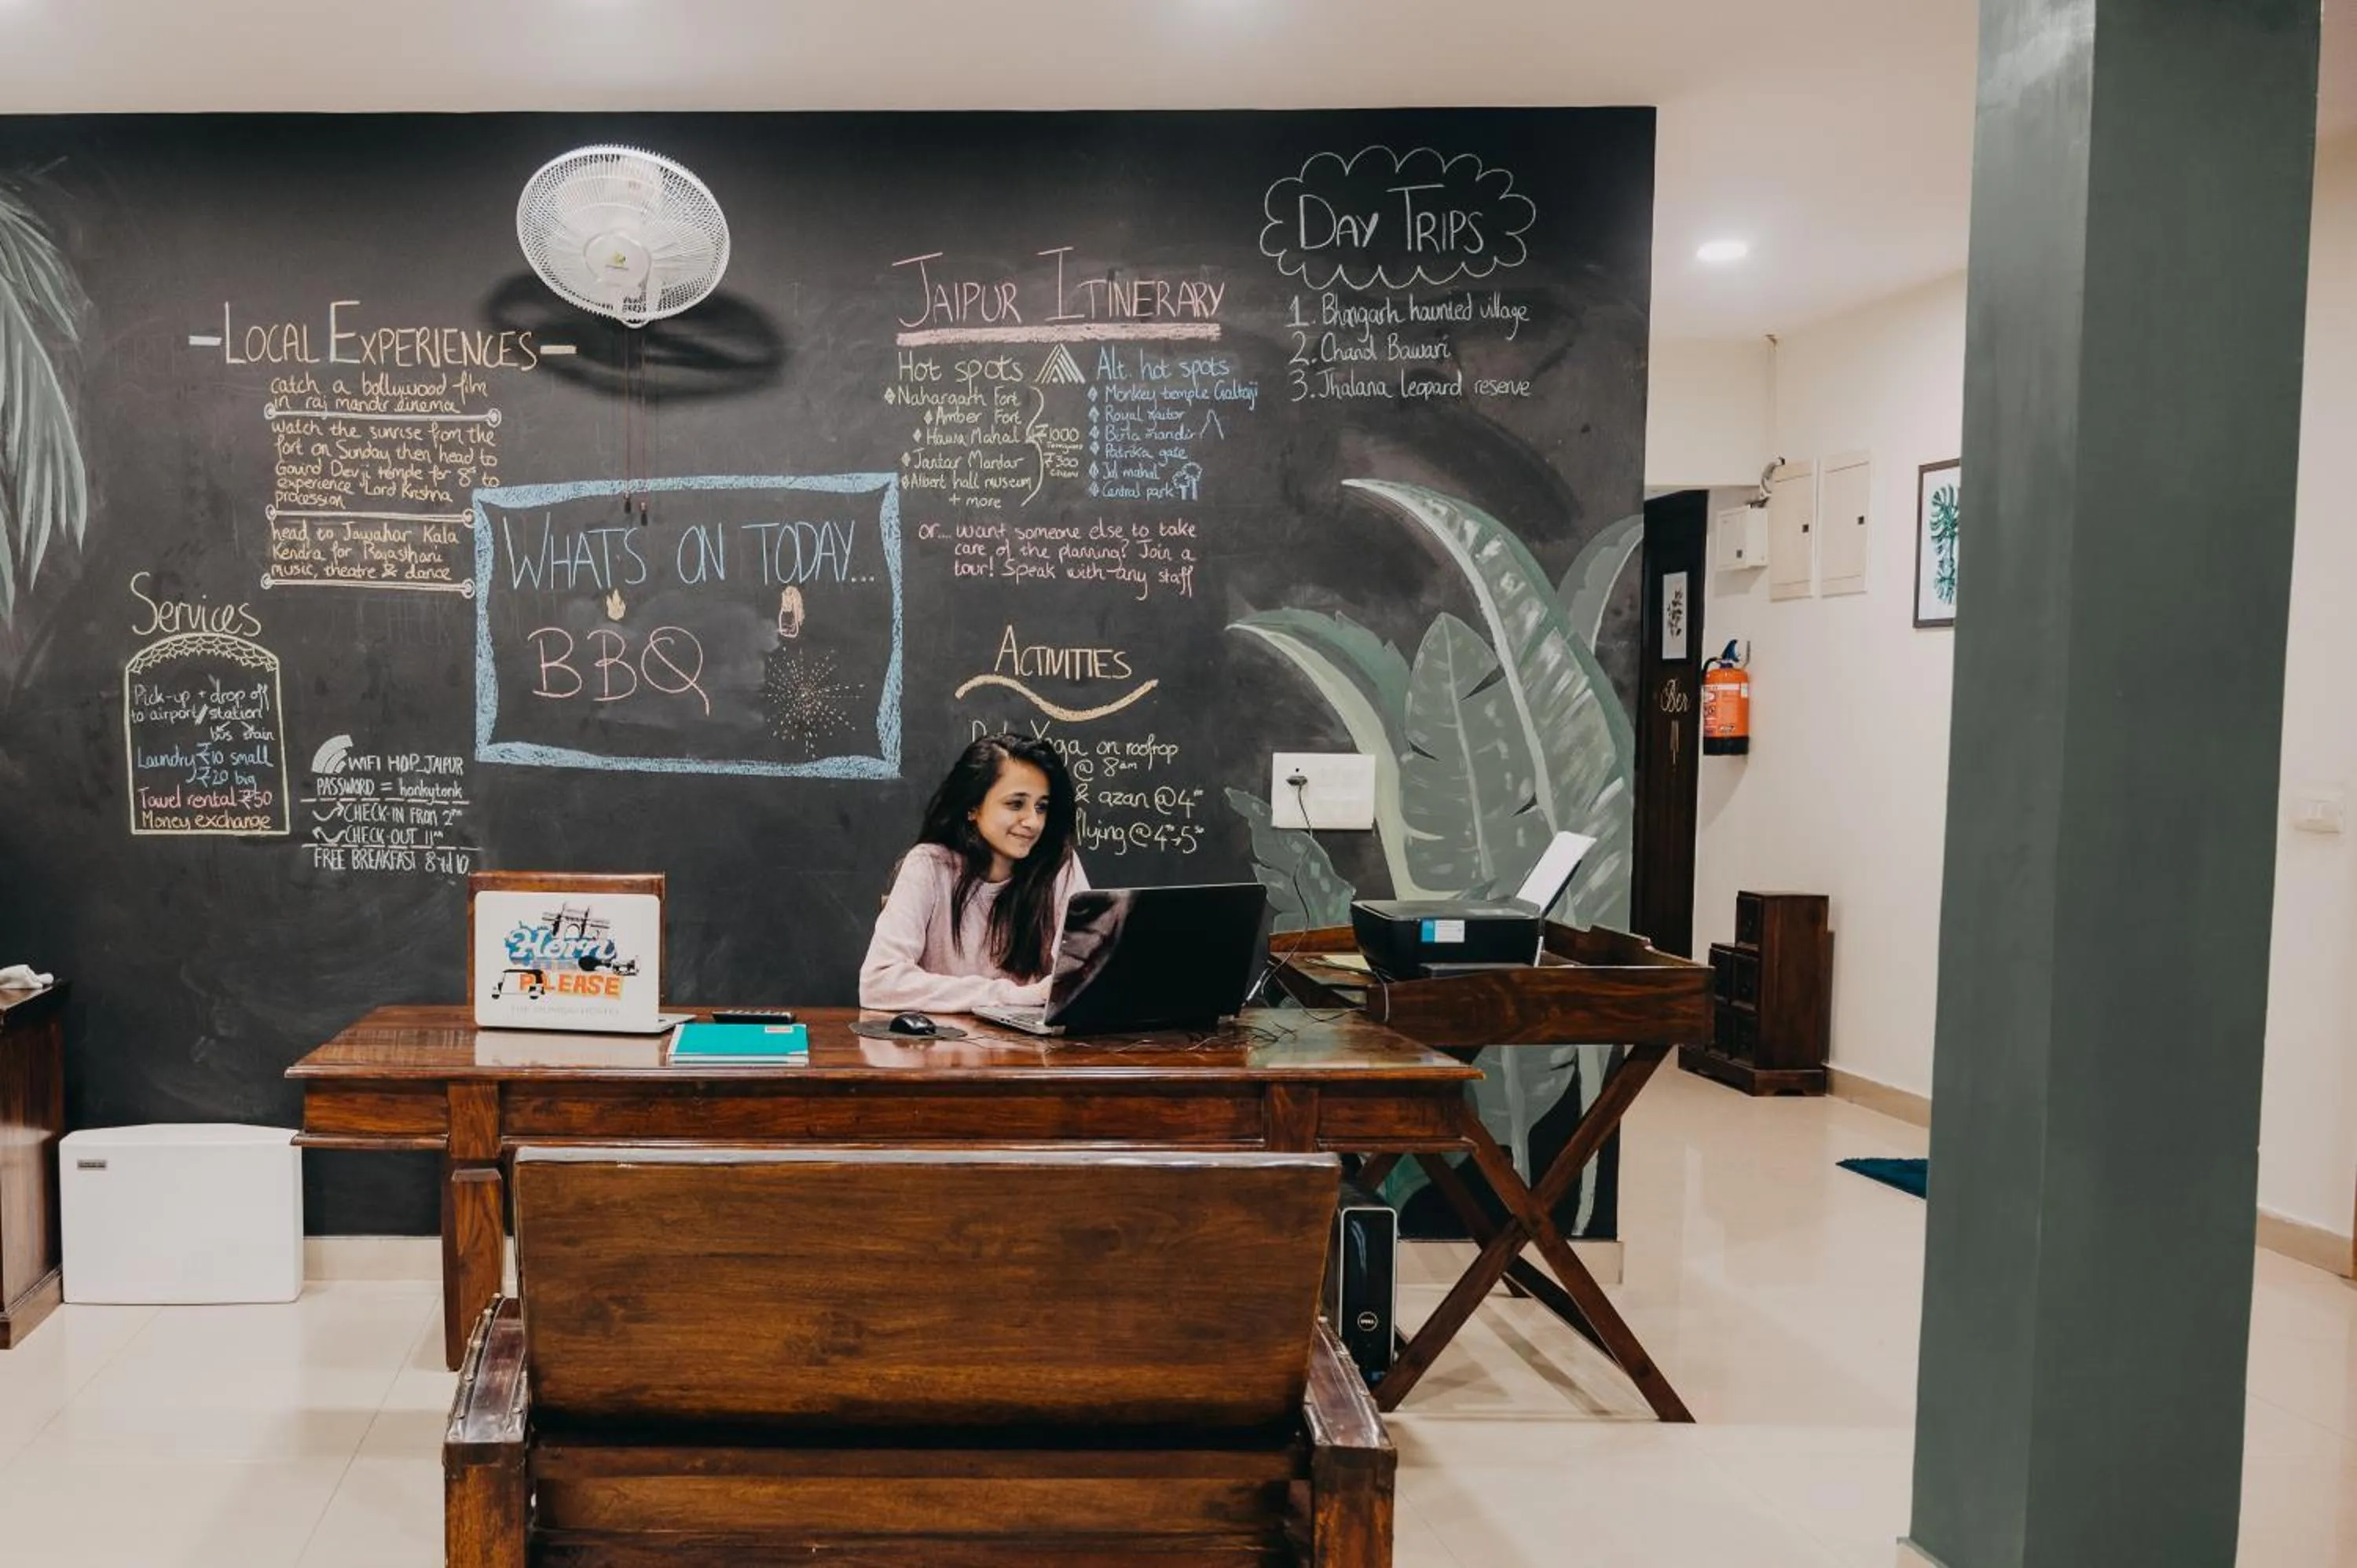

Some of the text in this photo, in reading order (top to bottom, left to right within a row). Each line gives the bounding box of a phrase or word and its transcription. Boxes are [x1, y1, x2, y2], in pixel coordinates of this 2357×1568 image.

[1299, 183, 1484, 254] DAY TRIPS
[892, 247, 1225, 328] JAIPUR ITINERARY
[1409, 292, 1472, 321] haunted
[1480, 291, 1530, 340] village
[225, 301, 537, 371] LOCAL EXPERIENCES
[1288, 331, 1318, 365] 2.
[1321, 332, 1376, 361] Chand
[898, 350, 1024, 394] Hot spots
[1097, 346, 1230, 386] Alt. hot spots
[270, 371, 488, 405] catch a bollywood film
[993, 387, 1021, 406] Fort
[1105, 383, 1157, 410] Monkey
[1160, 386, 1210, 406] temple
[1289, 369, 1315, 401] 3.
[1401, 368, 1462, 400] leopard
[1474, 380, 1530, 397] reserve
[272, 396, 290, 410] in
[936, 407, 1021, 426] Amber Fort
[1105, 405, 1143, 430] Royal
[330, 424, 361, 438] the
[372, 427, 423, 440] sunrise
[467, 424, 496, 446] the
[970, 424, 1021, 443] Mahal
[311, 442, 332, 458] on
[337, 440, 390, 469] Sunday
[396, 442, 431, 461] then
[439, 445, 474, 463] head
[480, 448, 497, 467] to
[277, 478, 355, 496] experience
[364, 481, 396, 496] Lord
[482, 472, 500, 488] to
[953, 471, 979, 489] hall
[984, 475, 1032, 491] museum
[1146, 482, 1175, 500] park
[966, 496, 1002, 508] more
[271, 518, 309, 544] head
[317, 527, 334, 541] to
[423, 524, 459, 544] Kala
[956, 517, 1197, 540] want someone else to take
[273, 543, 326, 561] Kendra
[331, 542, 352, 566] for
[677, 521, 725, 585] ON
[954, 544, 987, 556] care
[996, 539, 1012, 559] of
[1021, 544, 1050, 559] the
[1136, 539, 1172, 561] Join
[1182, 549, 1197, 562] a
[324, 564, 383, 579] theatre
[405, 564, 453, 581] dance
[954, 559, 1194, 600] tour! Speak with any staff
[130, 571, 262, 637] Services
[994, 625, 1132, 680] ACTIVITIES
[528, 626, 710, 716] BBQ
[134, 678, 269, 711] Pick-up drop off
[130, 709, 145, 723] to
[211, 726, 233, 741] bus
[1030, 720, 1089, 768] Yga
[1096, 741, 1121, 756] on
[137, 745, 197, 783] Laundry
[230, 745, 274, 767] small
[348, 756, 381, 771] WIFI
[137, 785, 181, 809] Towel
[187, 786, 236, 808] rental
[317, 778, 375, 797] PASSWORD
[1075, 783, 1090, 804] &
[1098, 791, 1150, 808] azan
[141, 810, 271, 832] Money exchange
[314, 848, 346, 870] FREE
[352, 848, 416, 870] BREAKFAST
